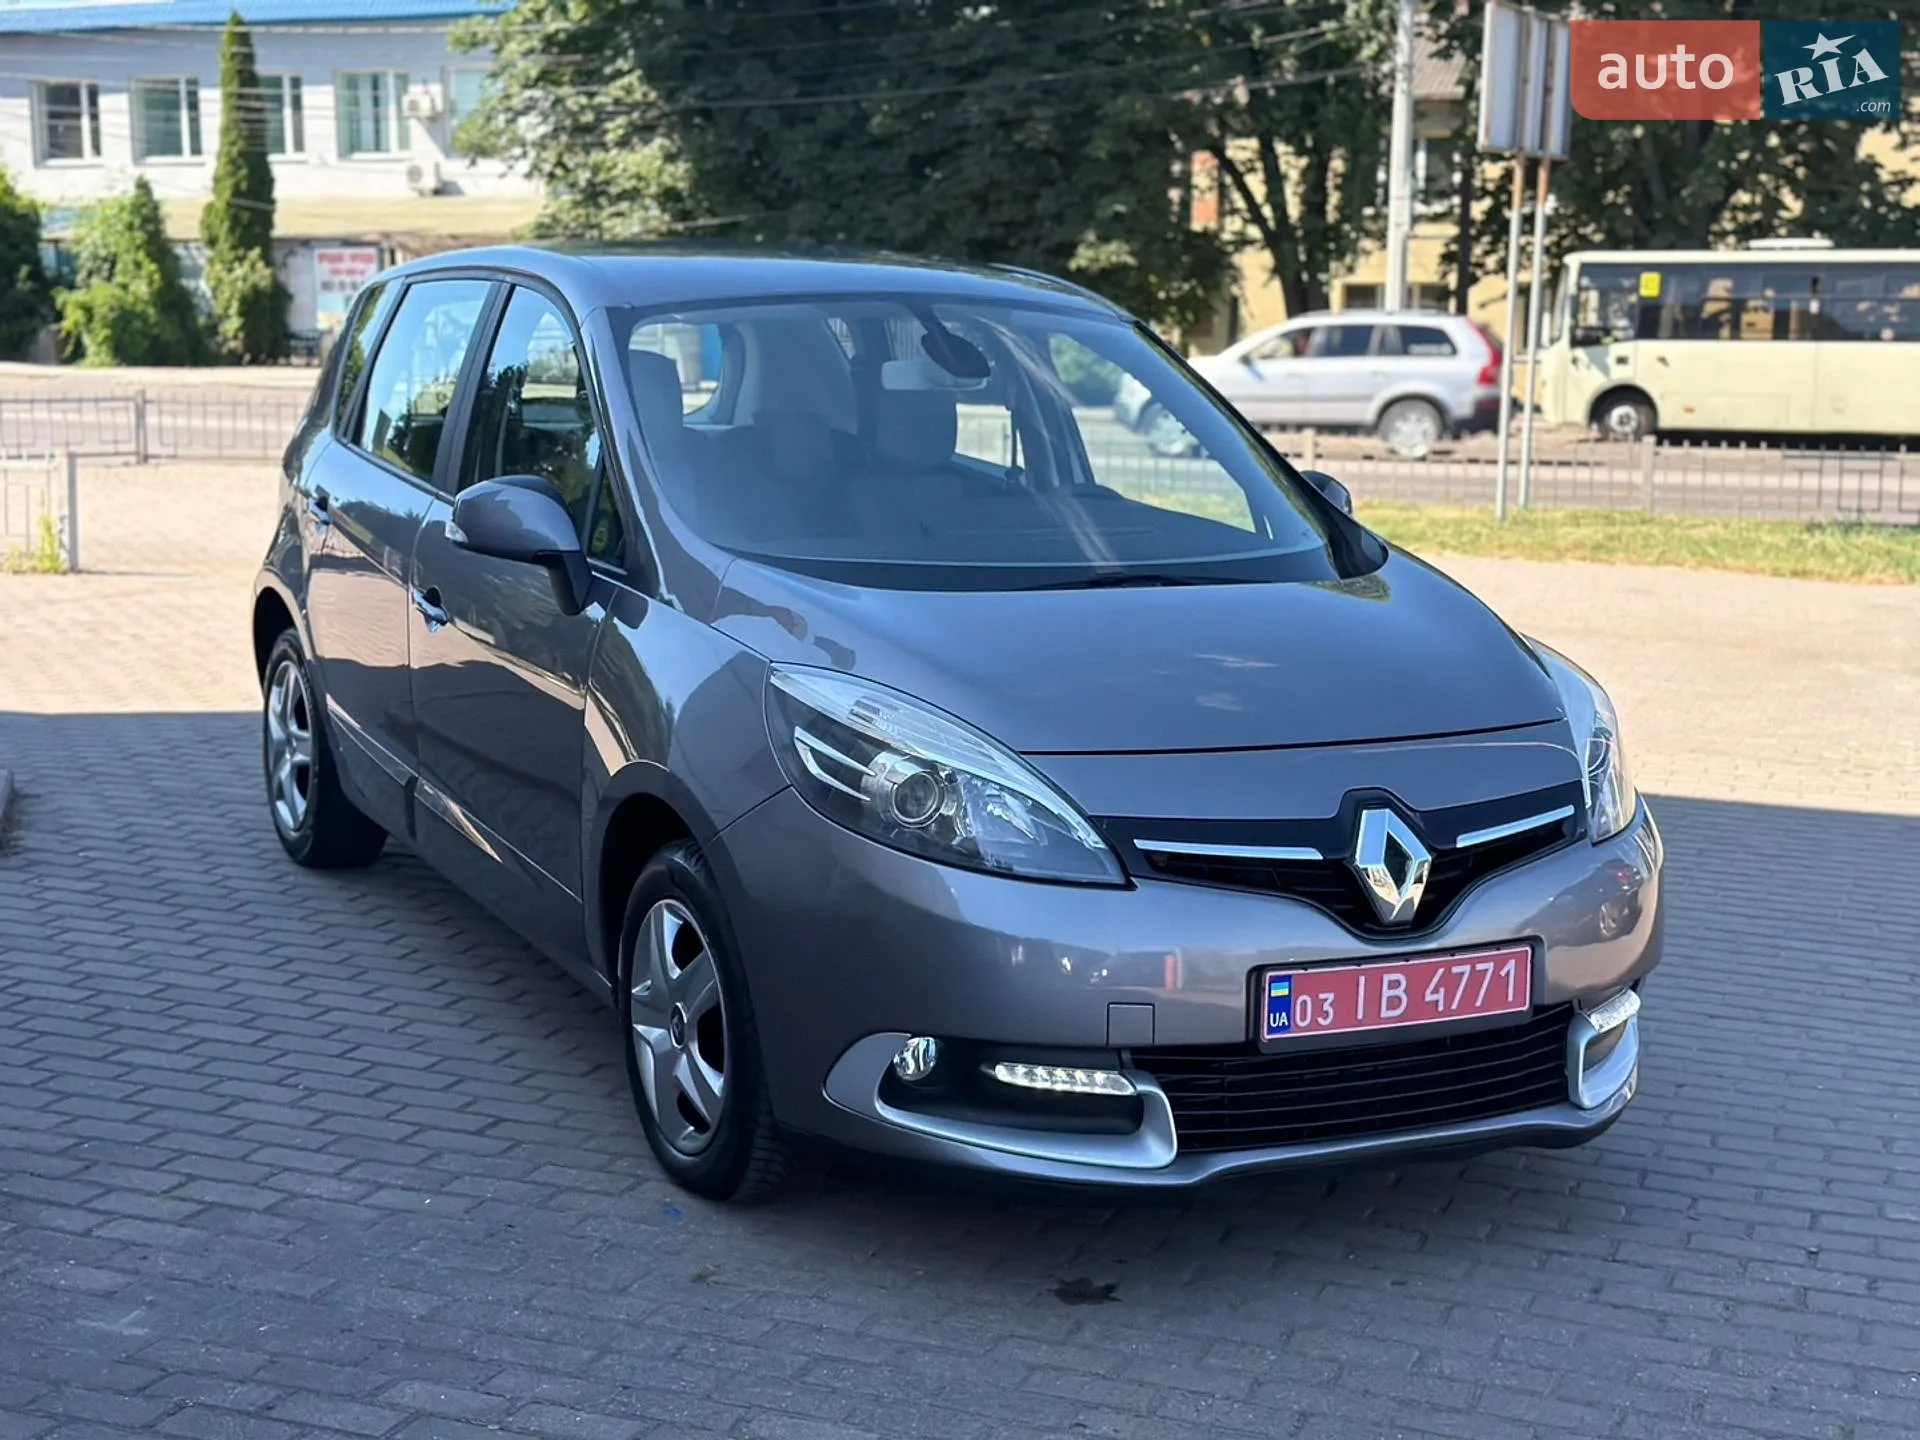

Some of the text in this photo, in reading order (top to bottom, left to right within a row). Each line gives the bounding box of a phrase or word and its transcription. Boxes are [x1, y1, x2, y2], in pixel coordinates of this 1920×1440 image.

[1295, 959, 1517, 1027] 03 IB 4771
[1270, 1011, 1288, 1027] UA
